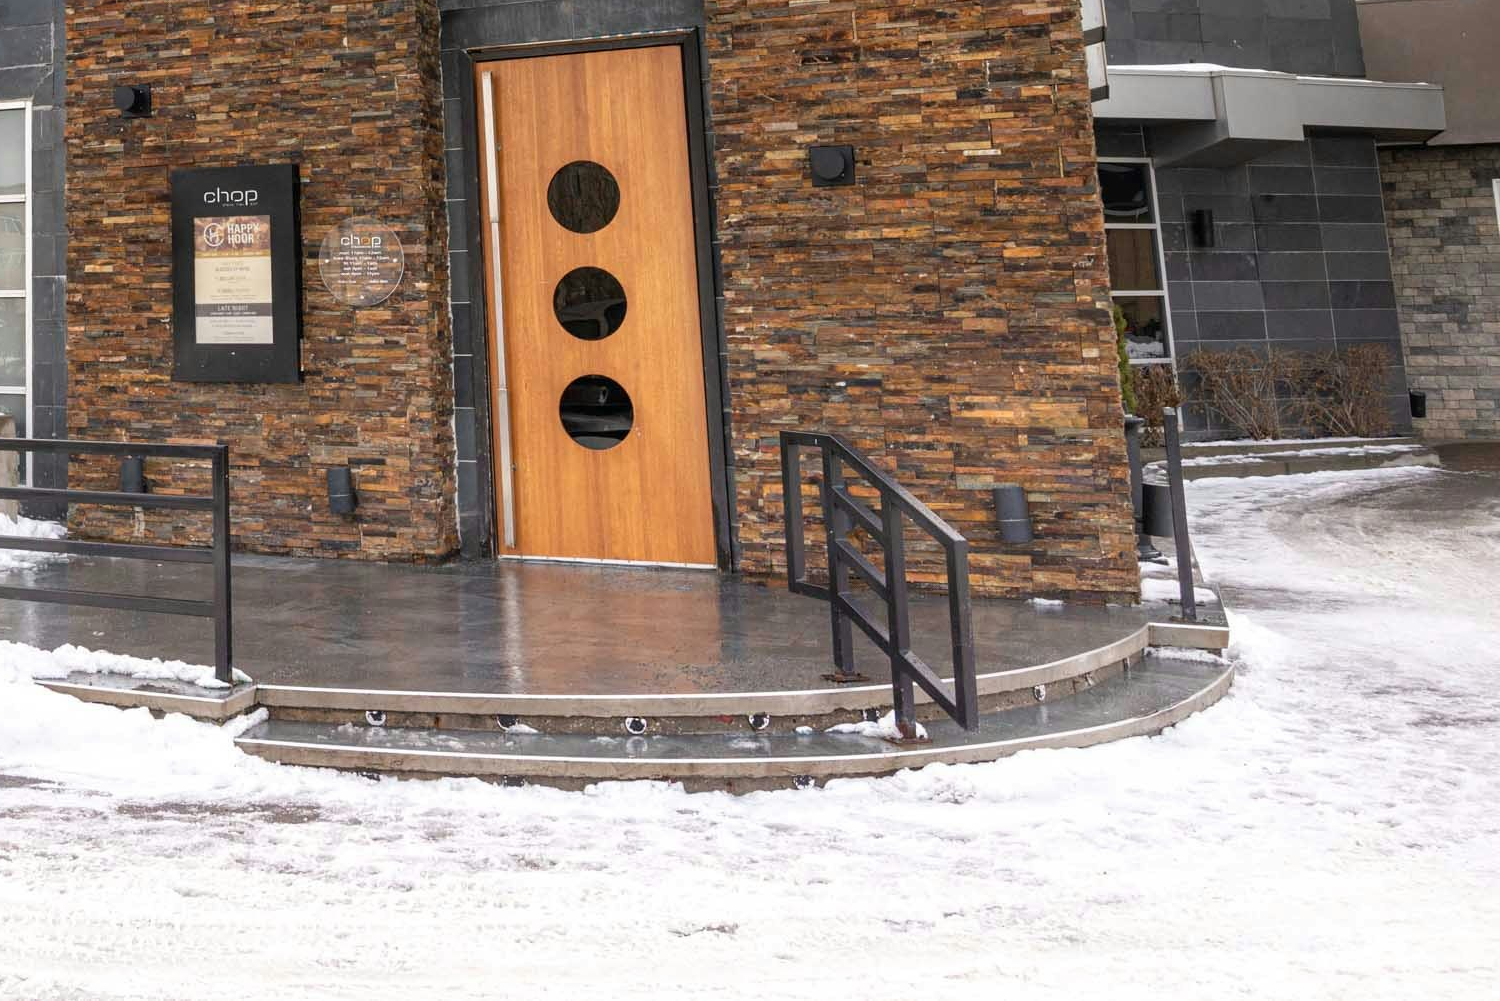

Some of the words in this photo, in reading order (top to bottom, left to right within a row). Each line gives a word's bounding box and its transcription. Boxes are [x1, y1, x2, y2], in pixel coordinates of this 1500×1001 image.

[203, 186, 258, 206] chop
[227, 222, 260, 234] HAPPY
[340, 233, 382, 249] chop
